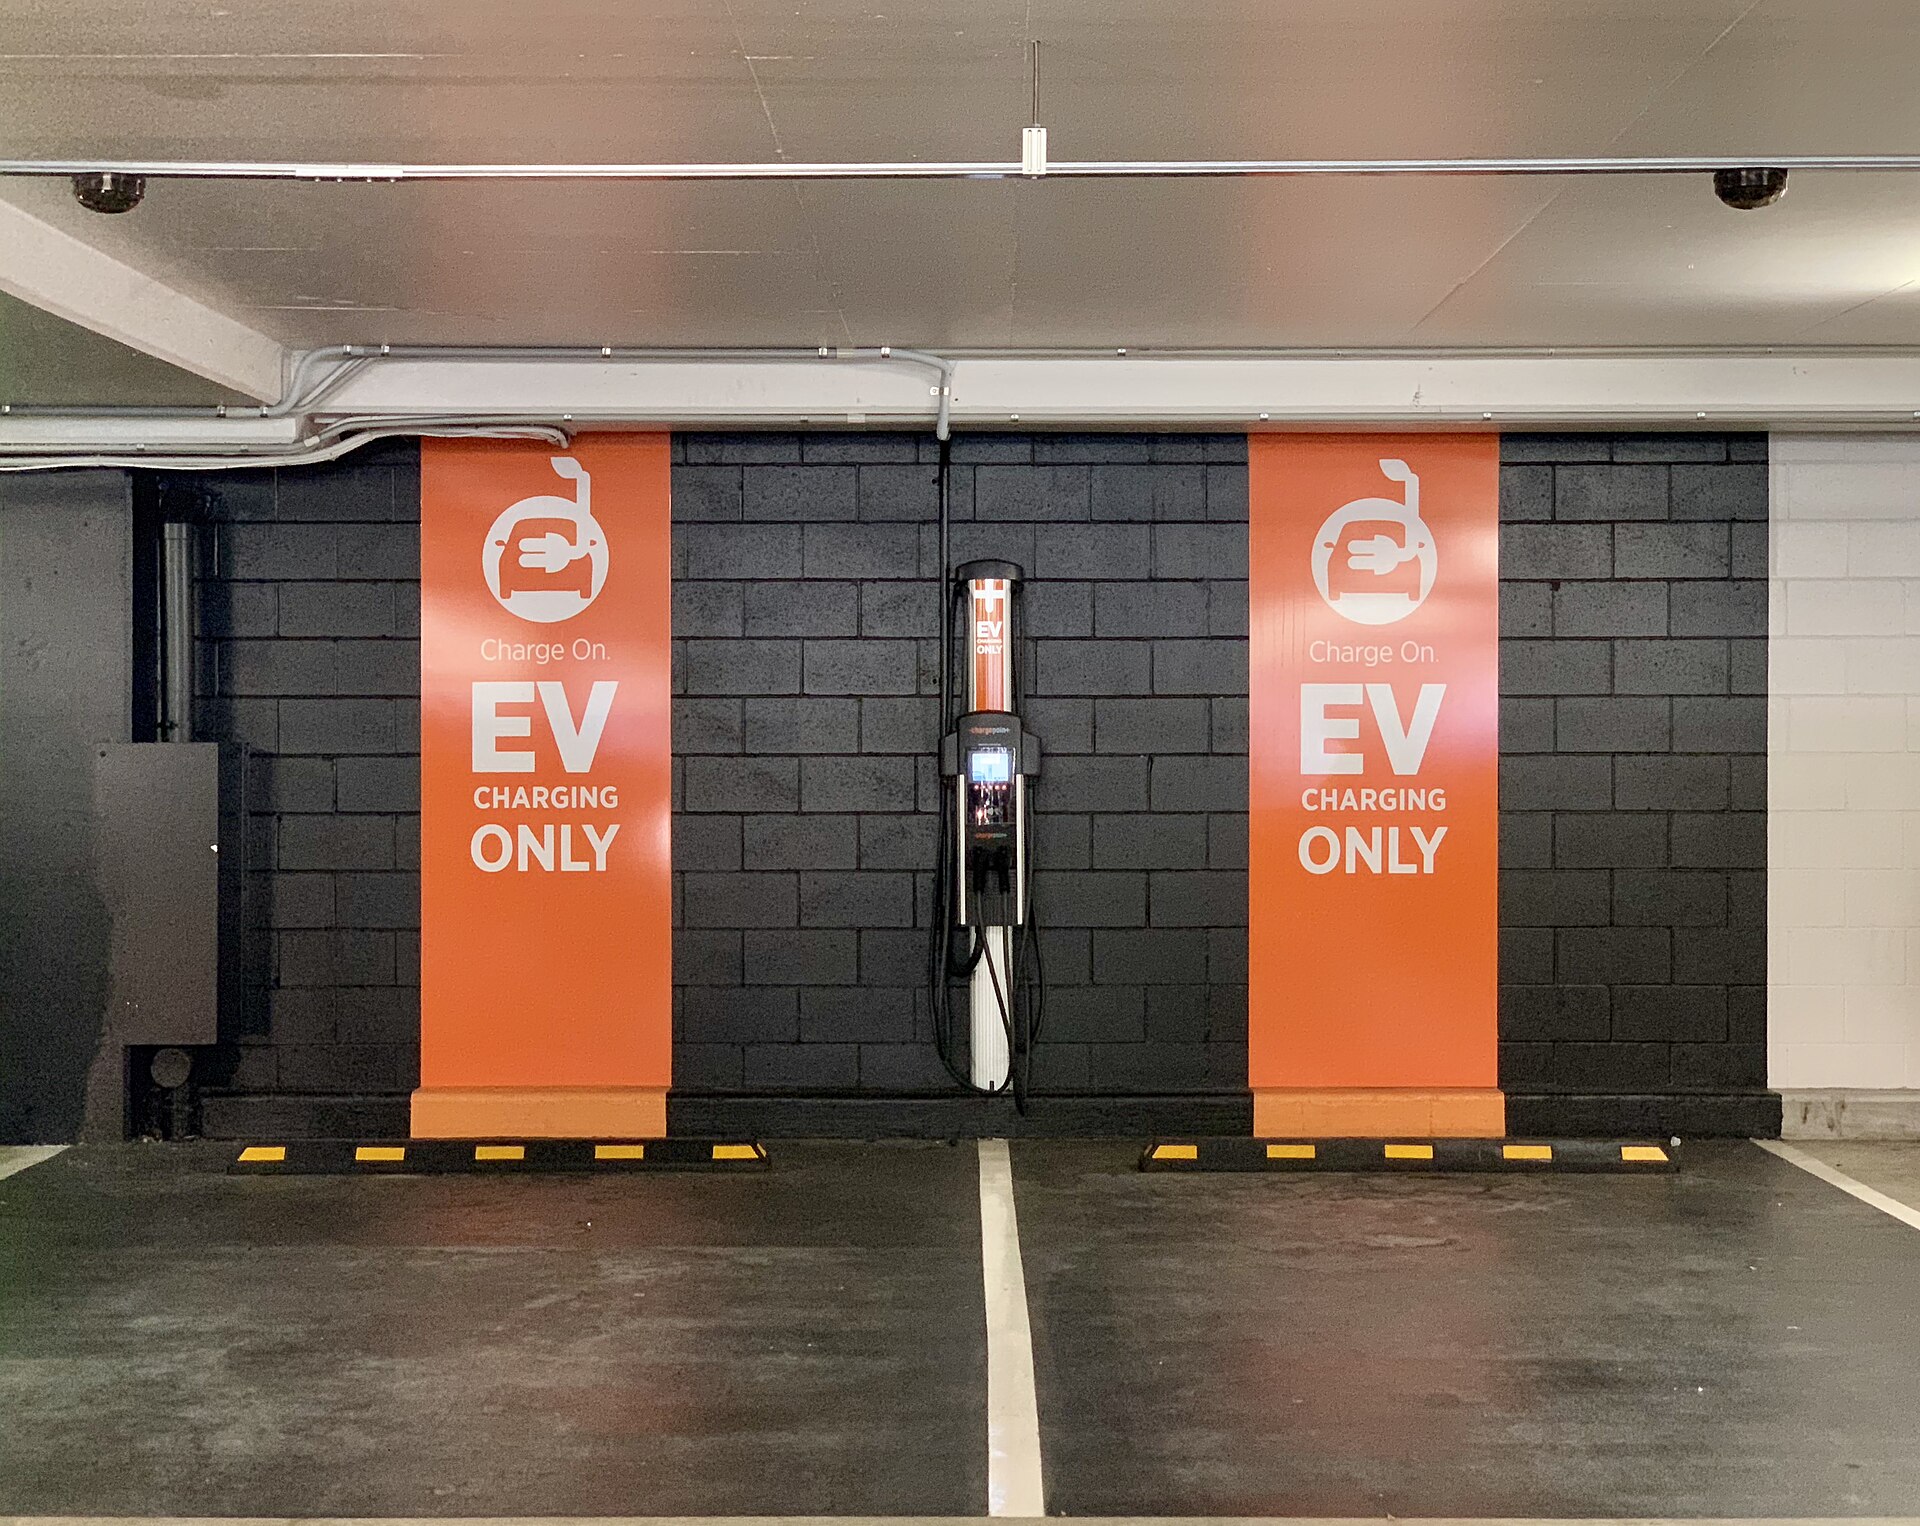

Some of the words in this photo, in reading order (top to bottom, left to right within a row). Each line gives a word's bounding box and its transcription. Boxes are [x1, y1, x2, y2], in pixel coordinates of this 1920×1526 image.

[976, 621, 1002, 637] EV
[480, 638, 565, 664] Charge
[571, 638, 610, 661] On.
[976, 644, 1002, 654] ONLY
[1309, 640, 1393, 667] Charge
[1400, 641, 1440, 663] On.
[472, 681, 619, 773] EV
[1300, 683, 1446, 775] EV
[473, 786, 618, 809] CHARGING
[1302, 788, 1446, 811] CHARGING
[470, 824, 620, 872] ONLY
[1298, 826, 1448, 874] ONLY
